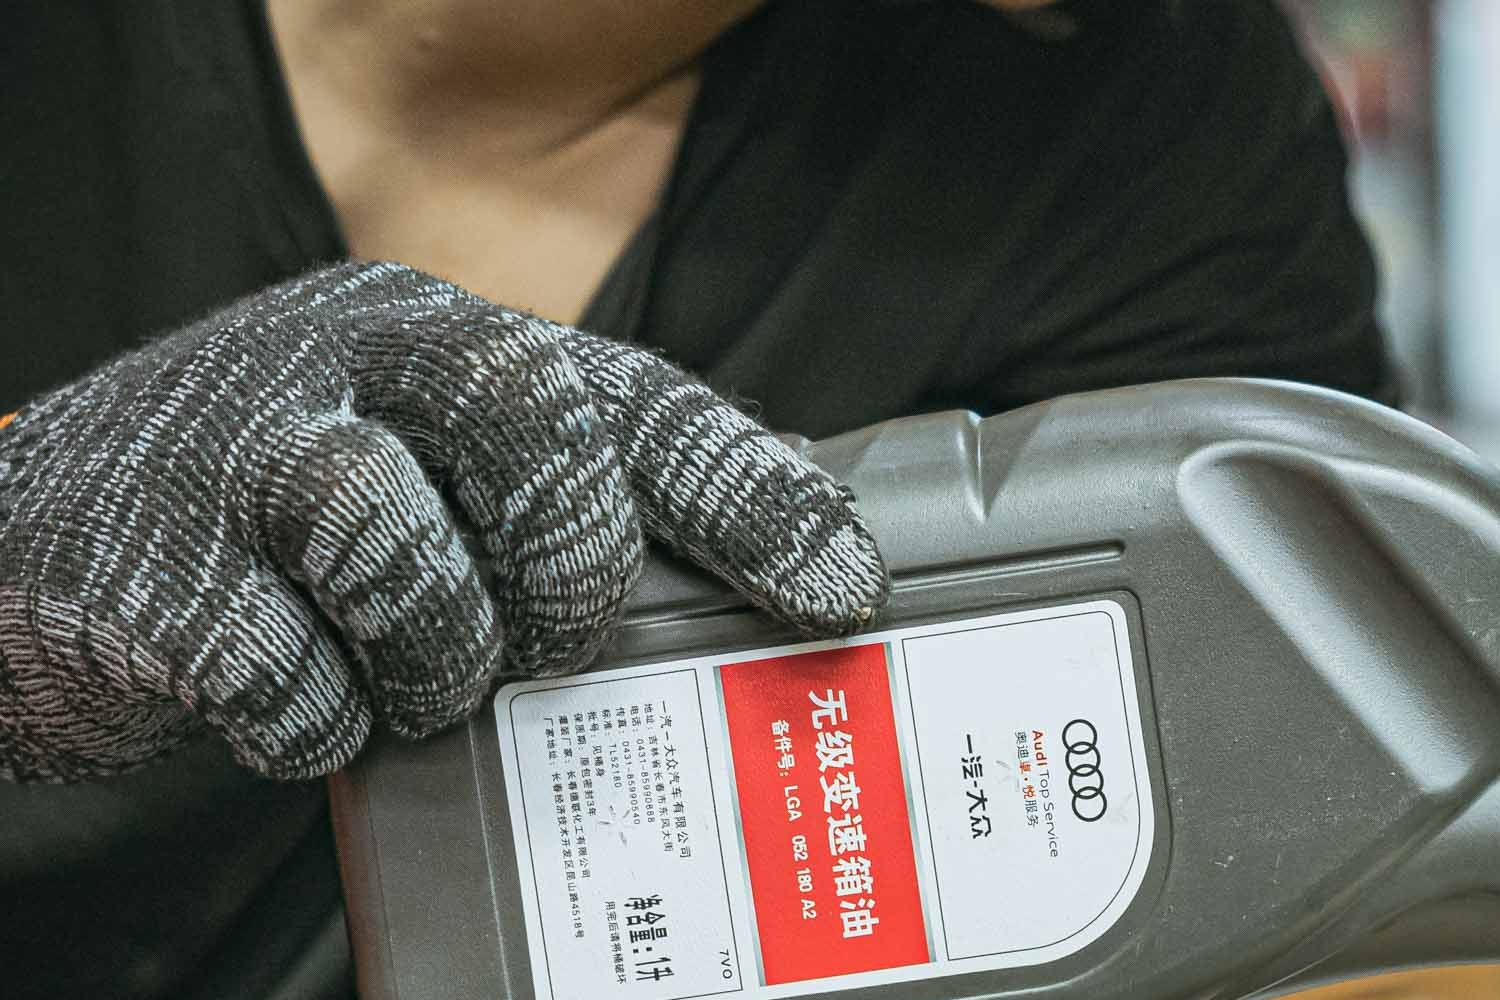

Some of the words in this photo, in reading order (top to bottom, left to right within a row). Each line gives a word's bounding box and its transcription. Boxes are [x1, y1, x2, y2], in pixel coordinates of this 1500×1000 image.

[1032, 730, 1048, 766] Audi
[1039, 769, 1050, 798] Top
[784, 785, 801, 821] LGA
[808, 688, 880, 939] 无级变速箱油
[1044, 802, 1058, 857] Service
[791, 835, 808, 861] 052
[797, 868, 813, 892] 180
[802, 899, 816, 919] A2
